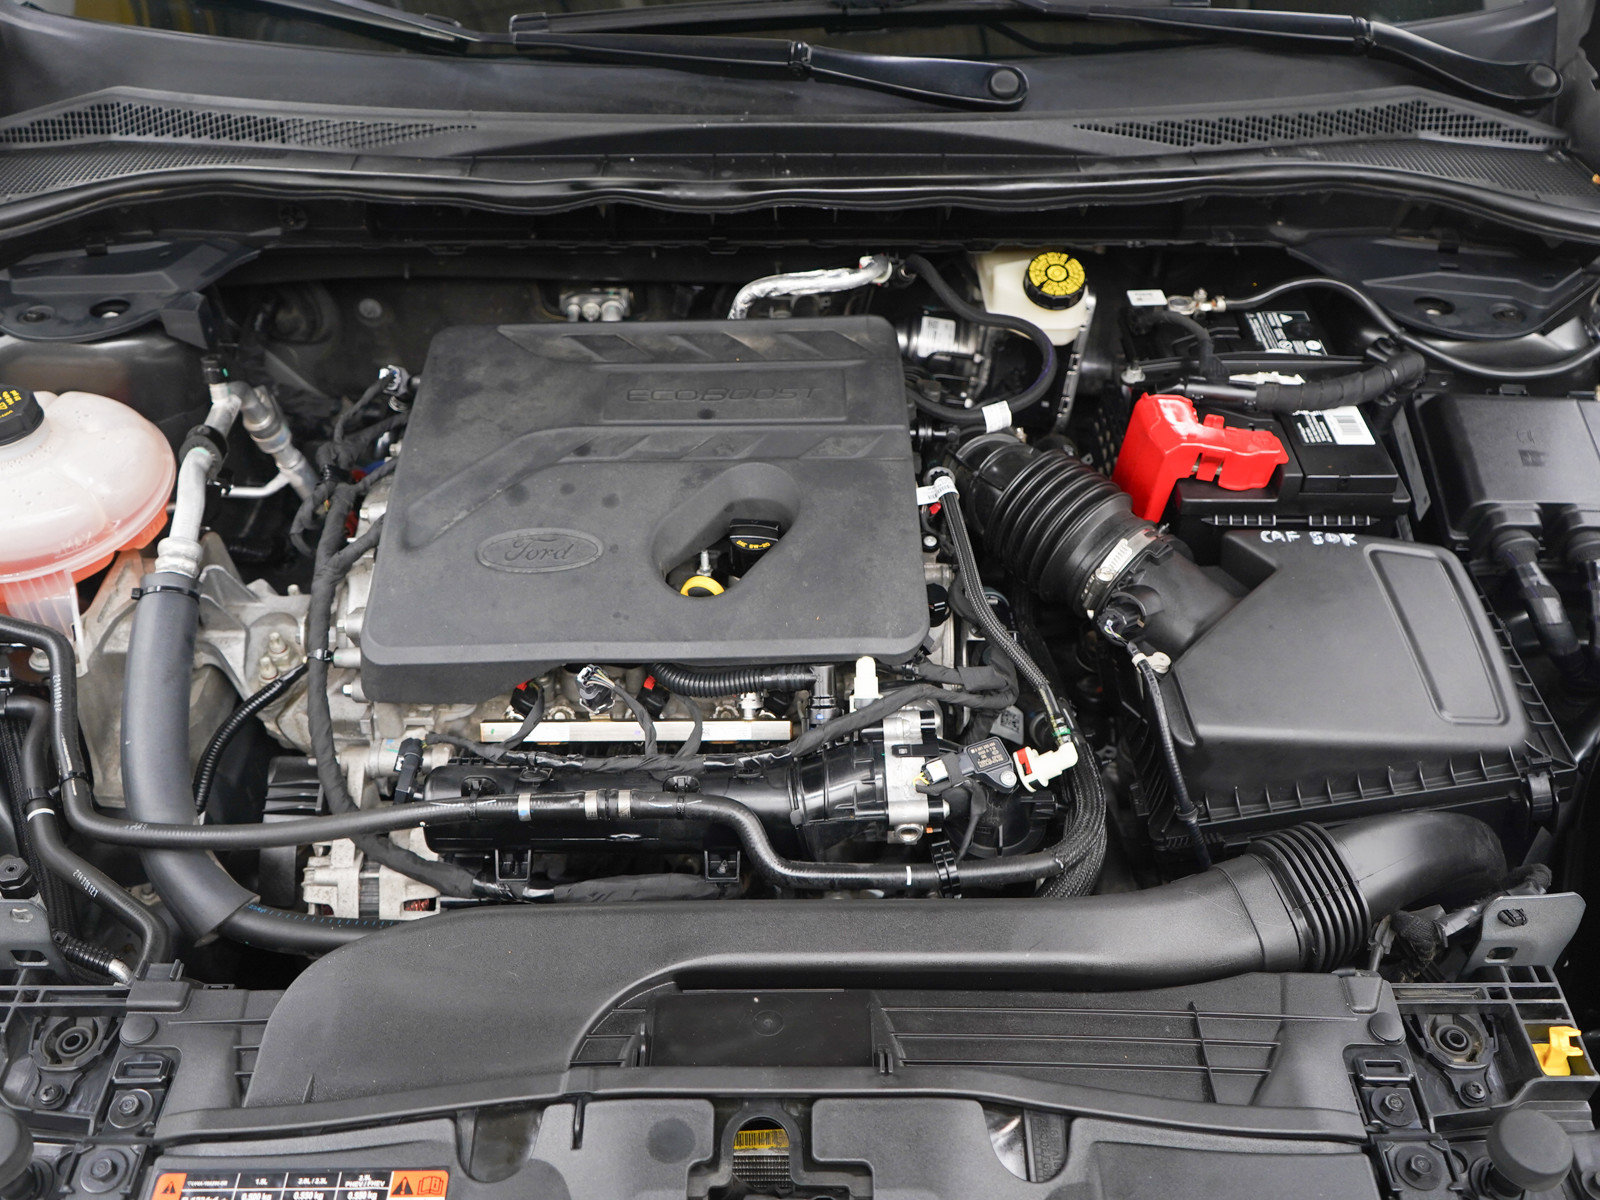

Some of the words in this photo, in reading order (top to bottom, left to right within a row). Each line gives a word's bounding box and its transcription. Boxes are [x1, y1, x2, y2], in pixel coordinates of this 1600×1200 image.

[627, 387, 824, 402] ECOBOOST
[1260, 530, 1300, 543] CAF
[504, 535, 575, 561] Ford
